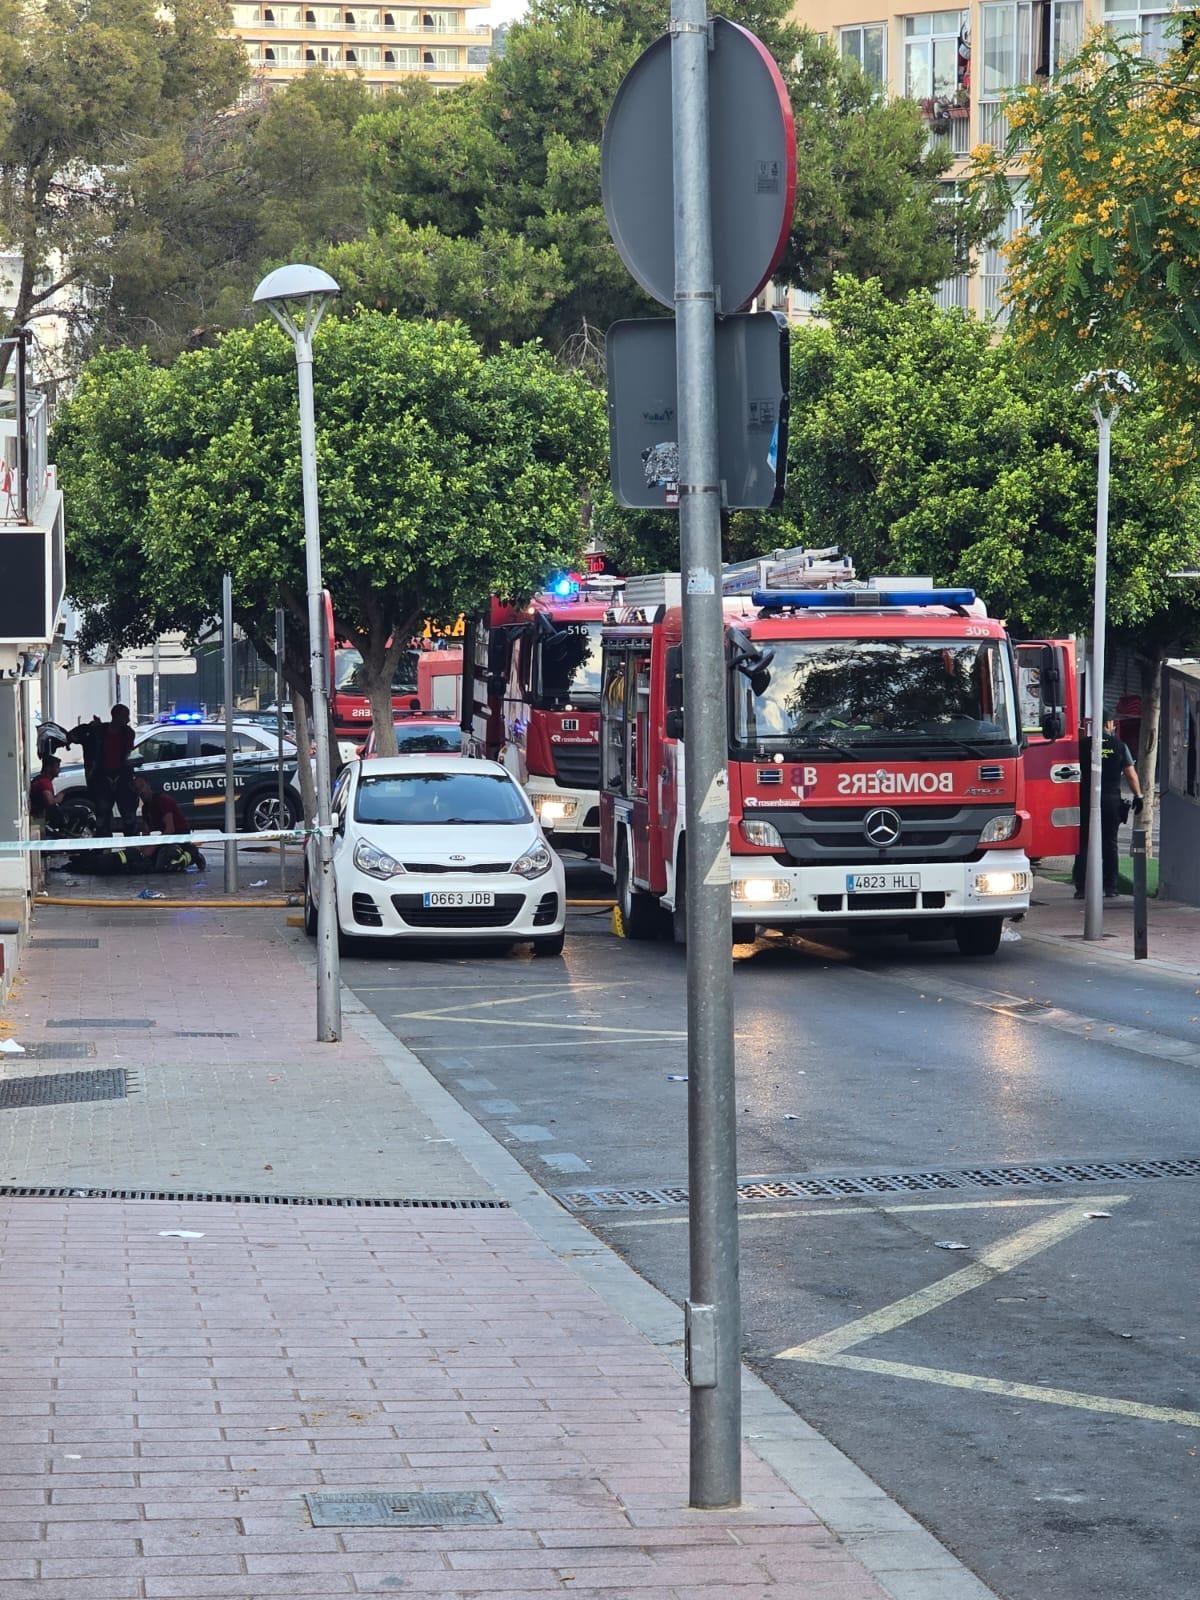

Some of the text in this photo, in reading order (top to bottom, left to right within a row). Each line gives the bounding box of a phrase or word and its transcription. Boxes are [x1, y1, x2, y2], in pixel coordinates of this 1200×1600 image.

[567, 625, 588, 635] 516
[964, 626, 990, 637] 306
[162, 777, 245, 791] GUARDIA CIIL
[856, 876, 918, 888] 4823 HLL
[431, 893, 491, 905] 0663 JDB
